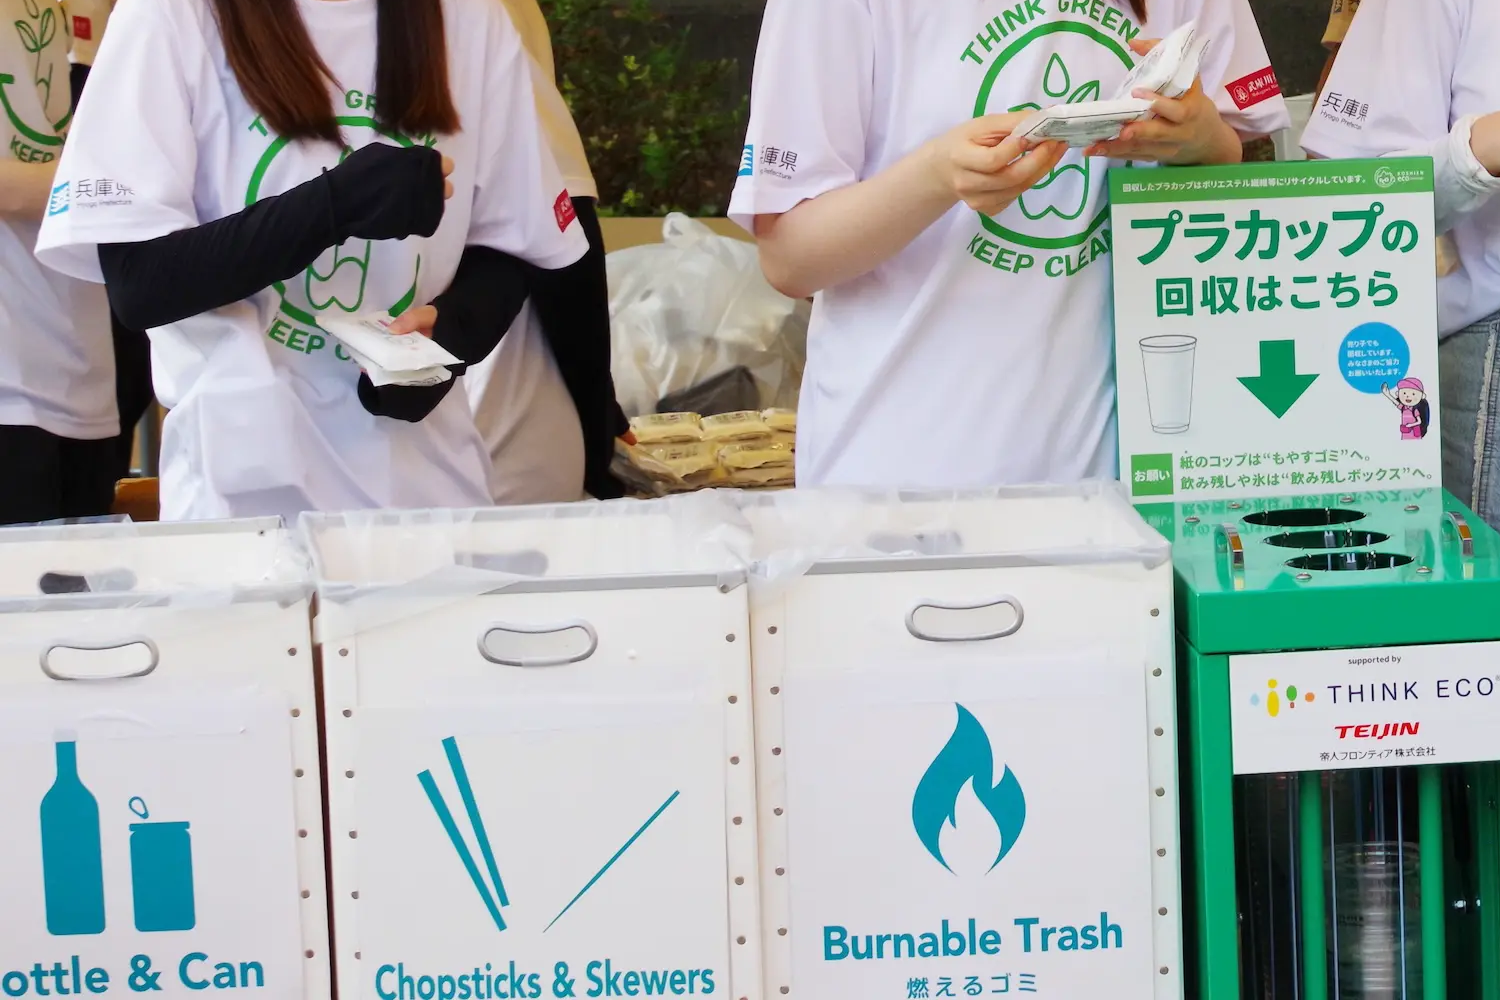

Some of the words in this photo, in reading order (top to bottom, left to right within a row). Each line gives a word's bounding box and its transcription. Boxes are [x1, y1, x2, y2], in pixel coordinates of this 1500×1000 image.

[1248, 72, 1276, 93] 武庫川
[760, 146, 798, 172] 庫県
[1130, 201, 1419, 265] プラカップの
[967, 232, 1034, 274] KEEP
[1156, 270, 1399, 317] 回収はこちら
[266, 318, 325, 354] EEP
[1134, 468, 1171, 482] お願い
[1348, 657, 1390, 666] supported
[1391, 655, 1402, 665] by
[1327, 681, 1419, 704] THINK
[1335, 722, 1420, 739] TEIJIN
[823, 918, 1002, 961] Burnable
[1015, 911, 1124, 952] Trash
[128, 953, 162, 991] &
[179, 952, 265, 990] Can
[375, 962, 542, 1000] Chopsticks
[552, 960, 576, 997] &
[586, 957, 716, 999] Skewers
[906, 973, 1039, 999] 燃えるゴミ
